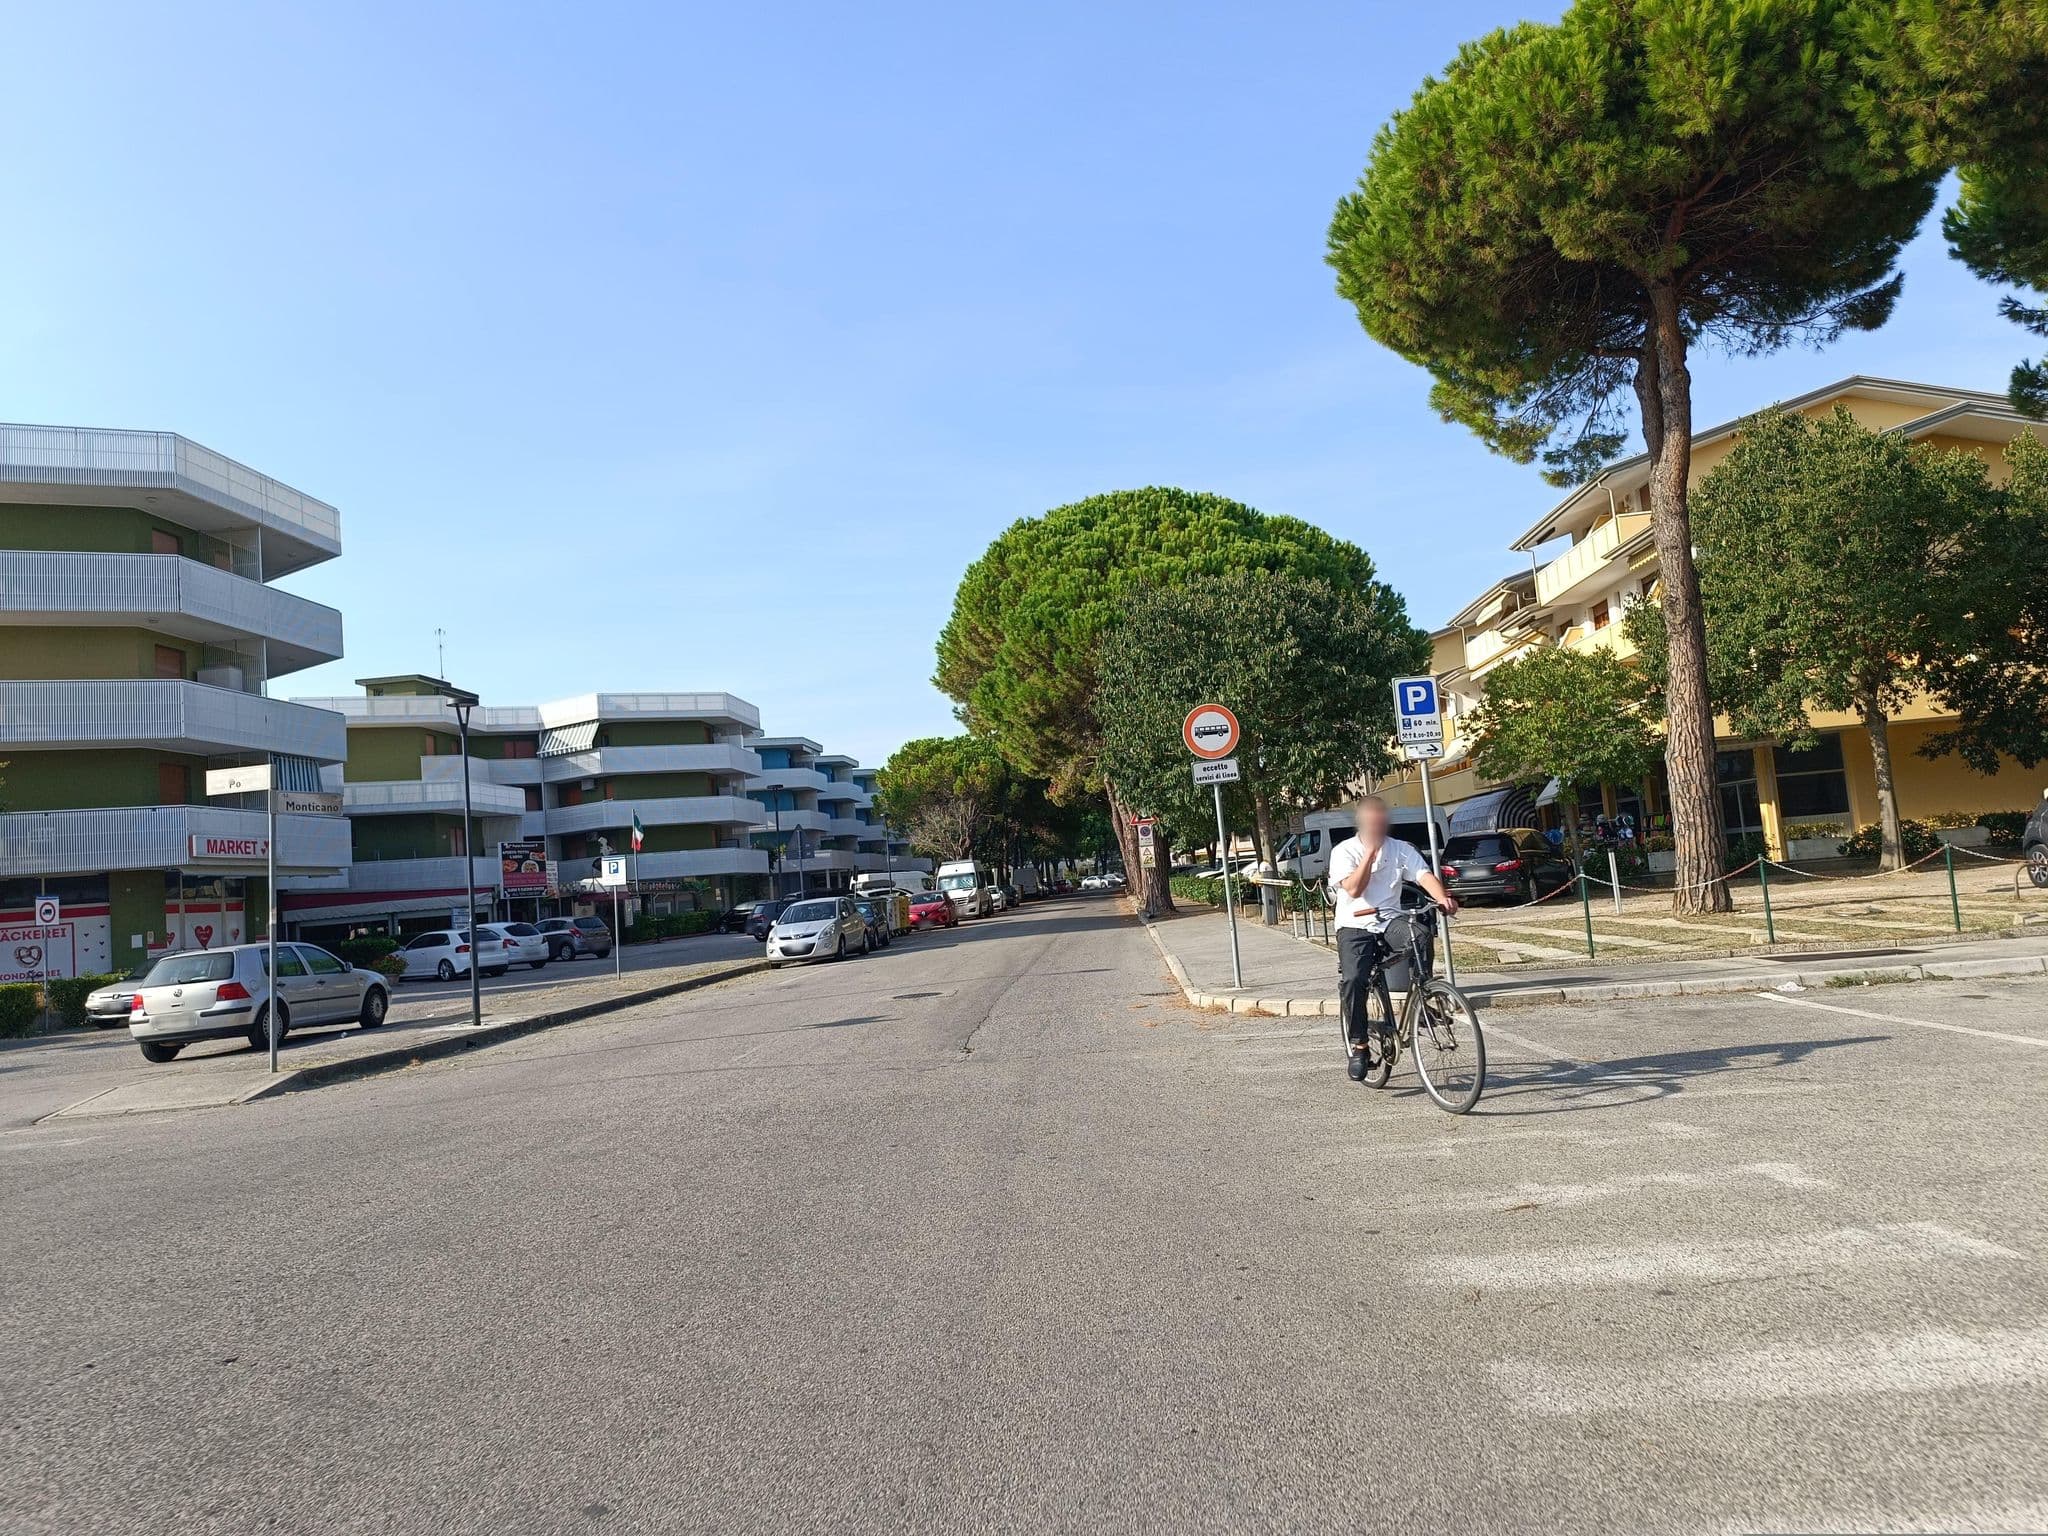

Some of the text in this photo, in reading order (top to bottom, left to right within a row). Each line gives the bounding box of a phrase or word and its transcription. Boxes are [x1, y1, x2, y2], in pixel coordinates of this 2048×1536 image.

[1406, 686, 1427, 711] P
[1202, 763, 1228, 772] eccetto
[1195, 774, 1215, 782] servizi
[1222, 771, 1237, 779] linea
[286, 801, 339, 812] Monticano
[206, 839, 258, 855] MARKET
[610, 862, 618, 874] P
